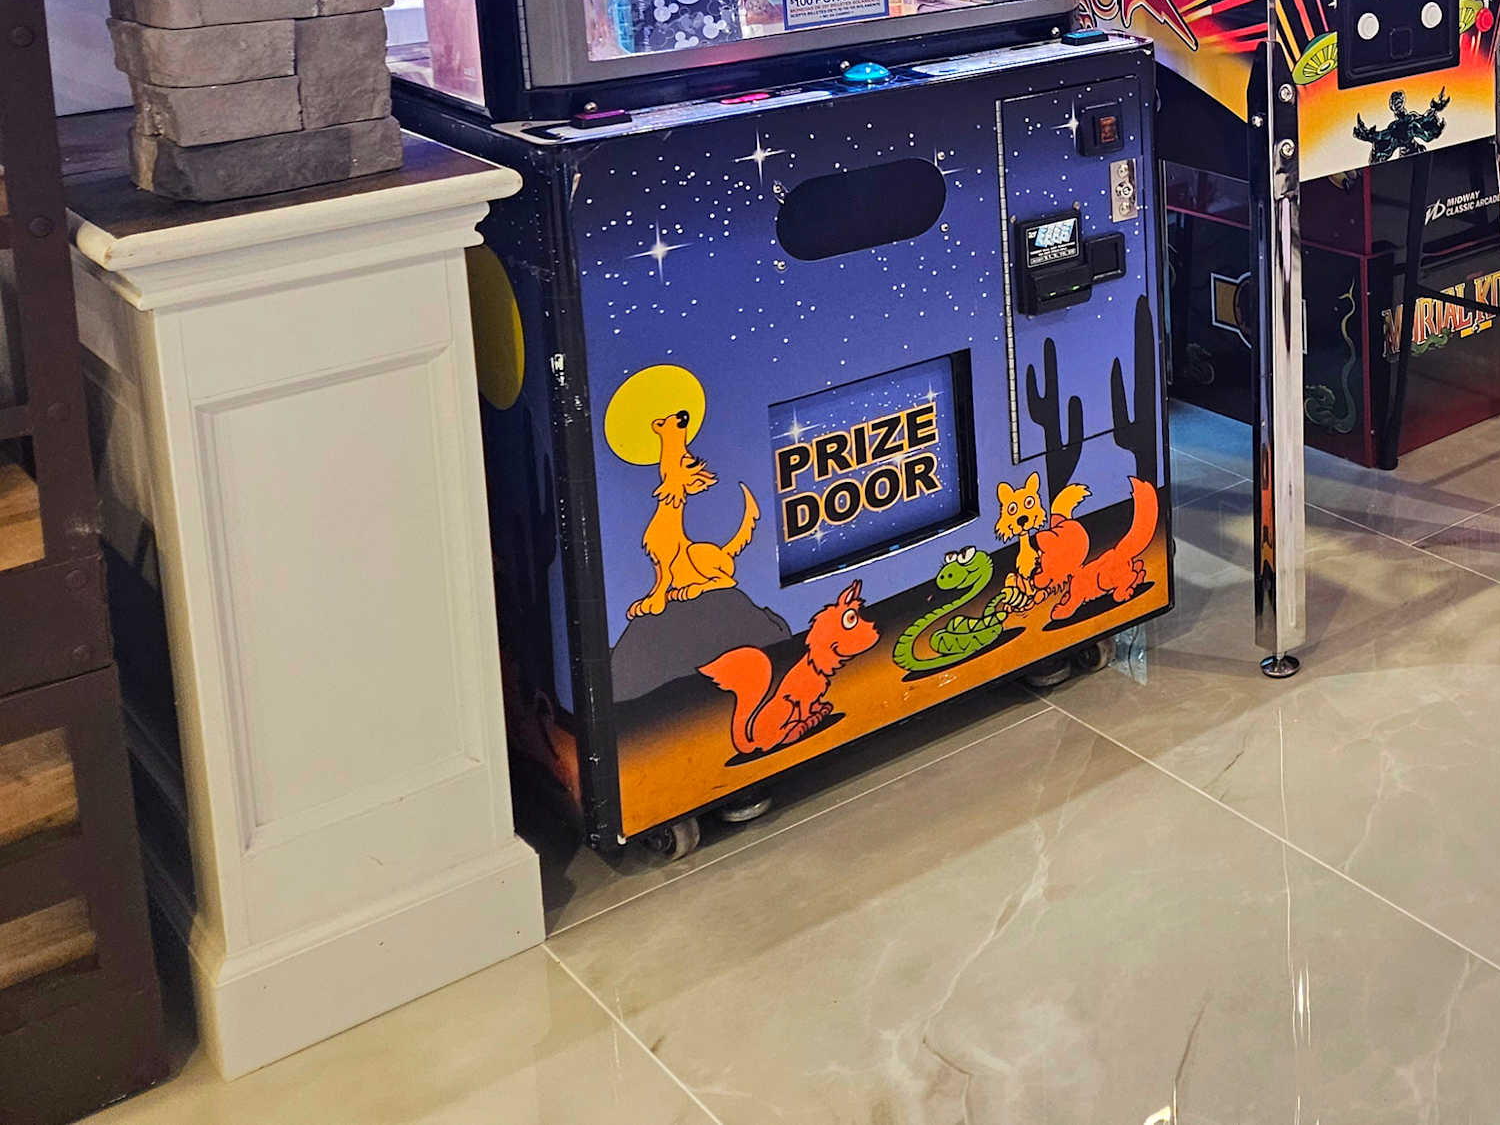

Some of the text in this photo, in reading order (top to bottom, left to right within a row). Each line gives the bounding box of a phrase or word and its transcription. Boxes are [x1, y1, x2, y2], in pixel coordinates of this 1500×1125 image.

[1446, 190, 1480, 207] MIDWAY
[1446, 201, 1475, 216] CLASSIC
[776, 402, 939, 493] PRIZE
[782, 452, 943, 543] DOOR
